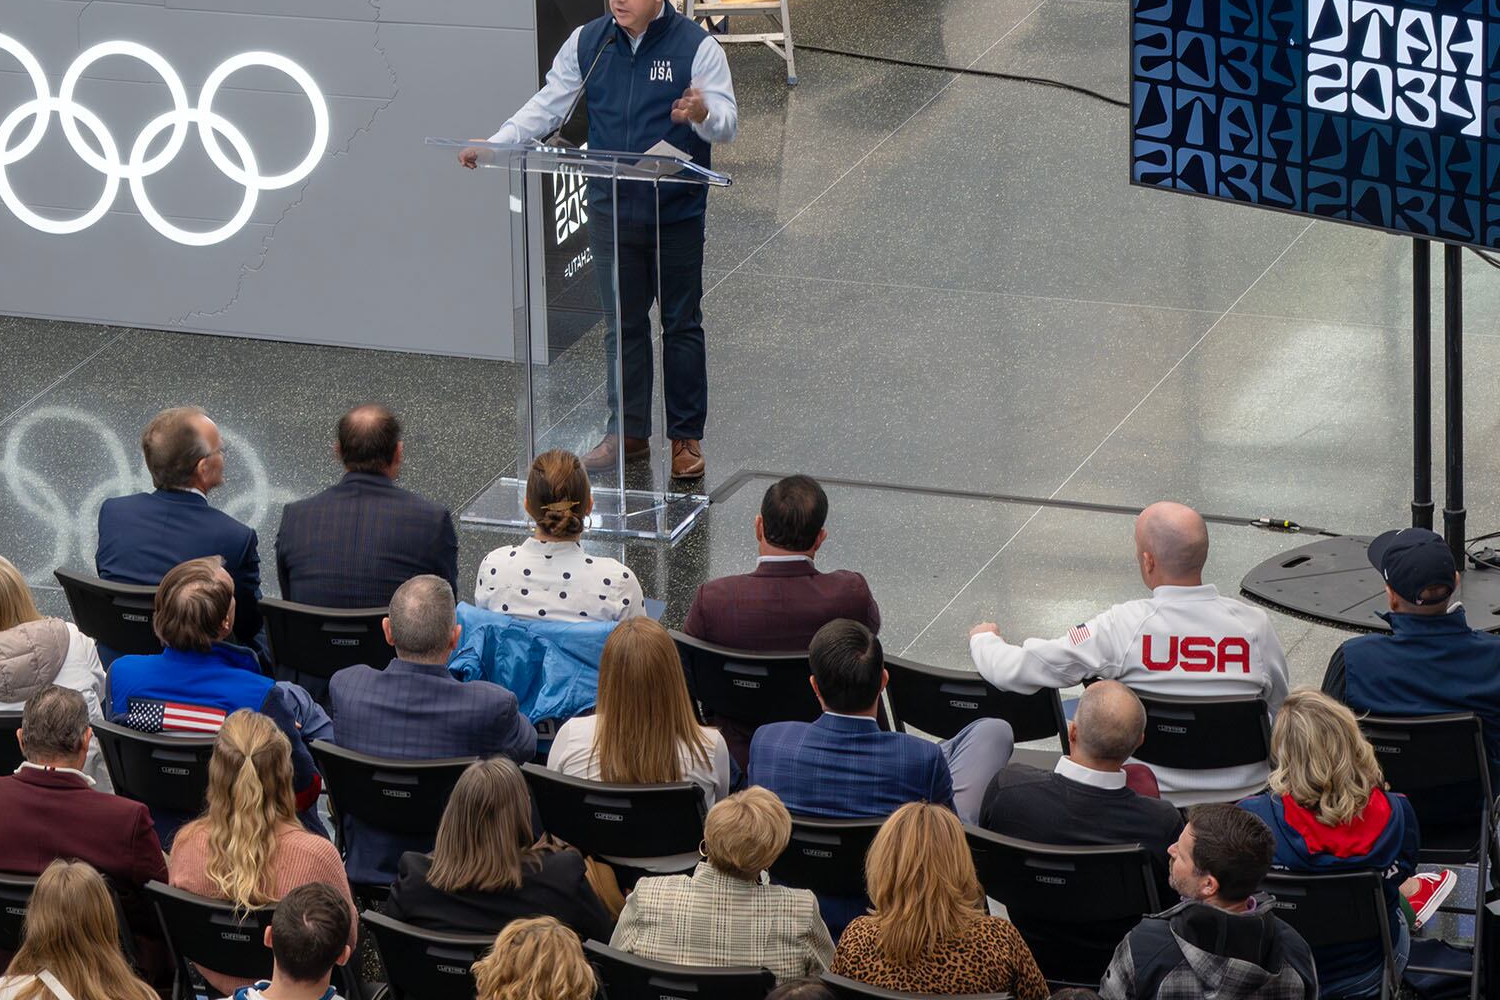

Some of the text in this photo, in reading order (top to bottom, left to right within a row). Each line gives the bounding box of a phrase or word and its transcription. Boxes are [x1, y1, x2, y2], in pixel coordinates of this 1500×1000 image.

[650, 66, 673, 82] USA
[1307, 52, 1482, 137] 2034
[1142, 634, 1250, 673] USA
